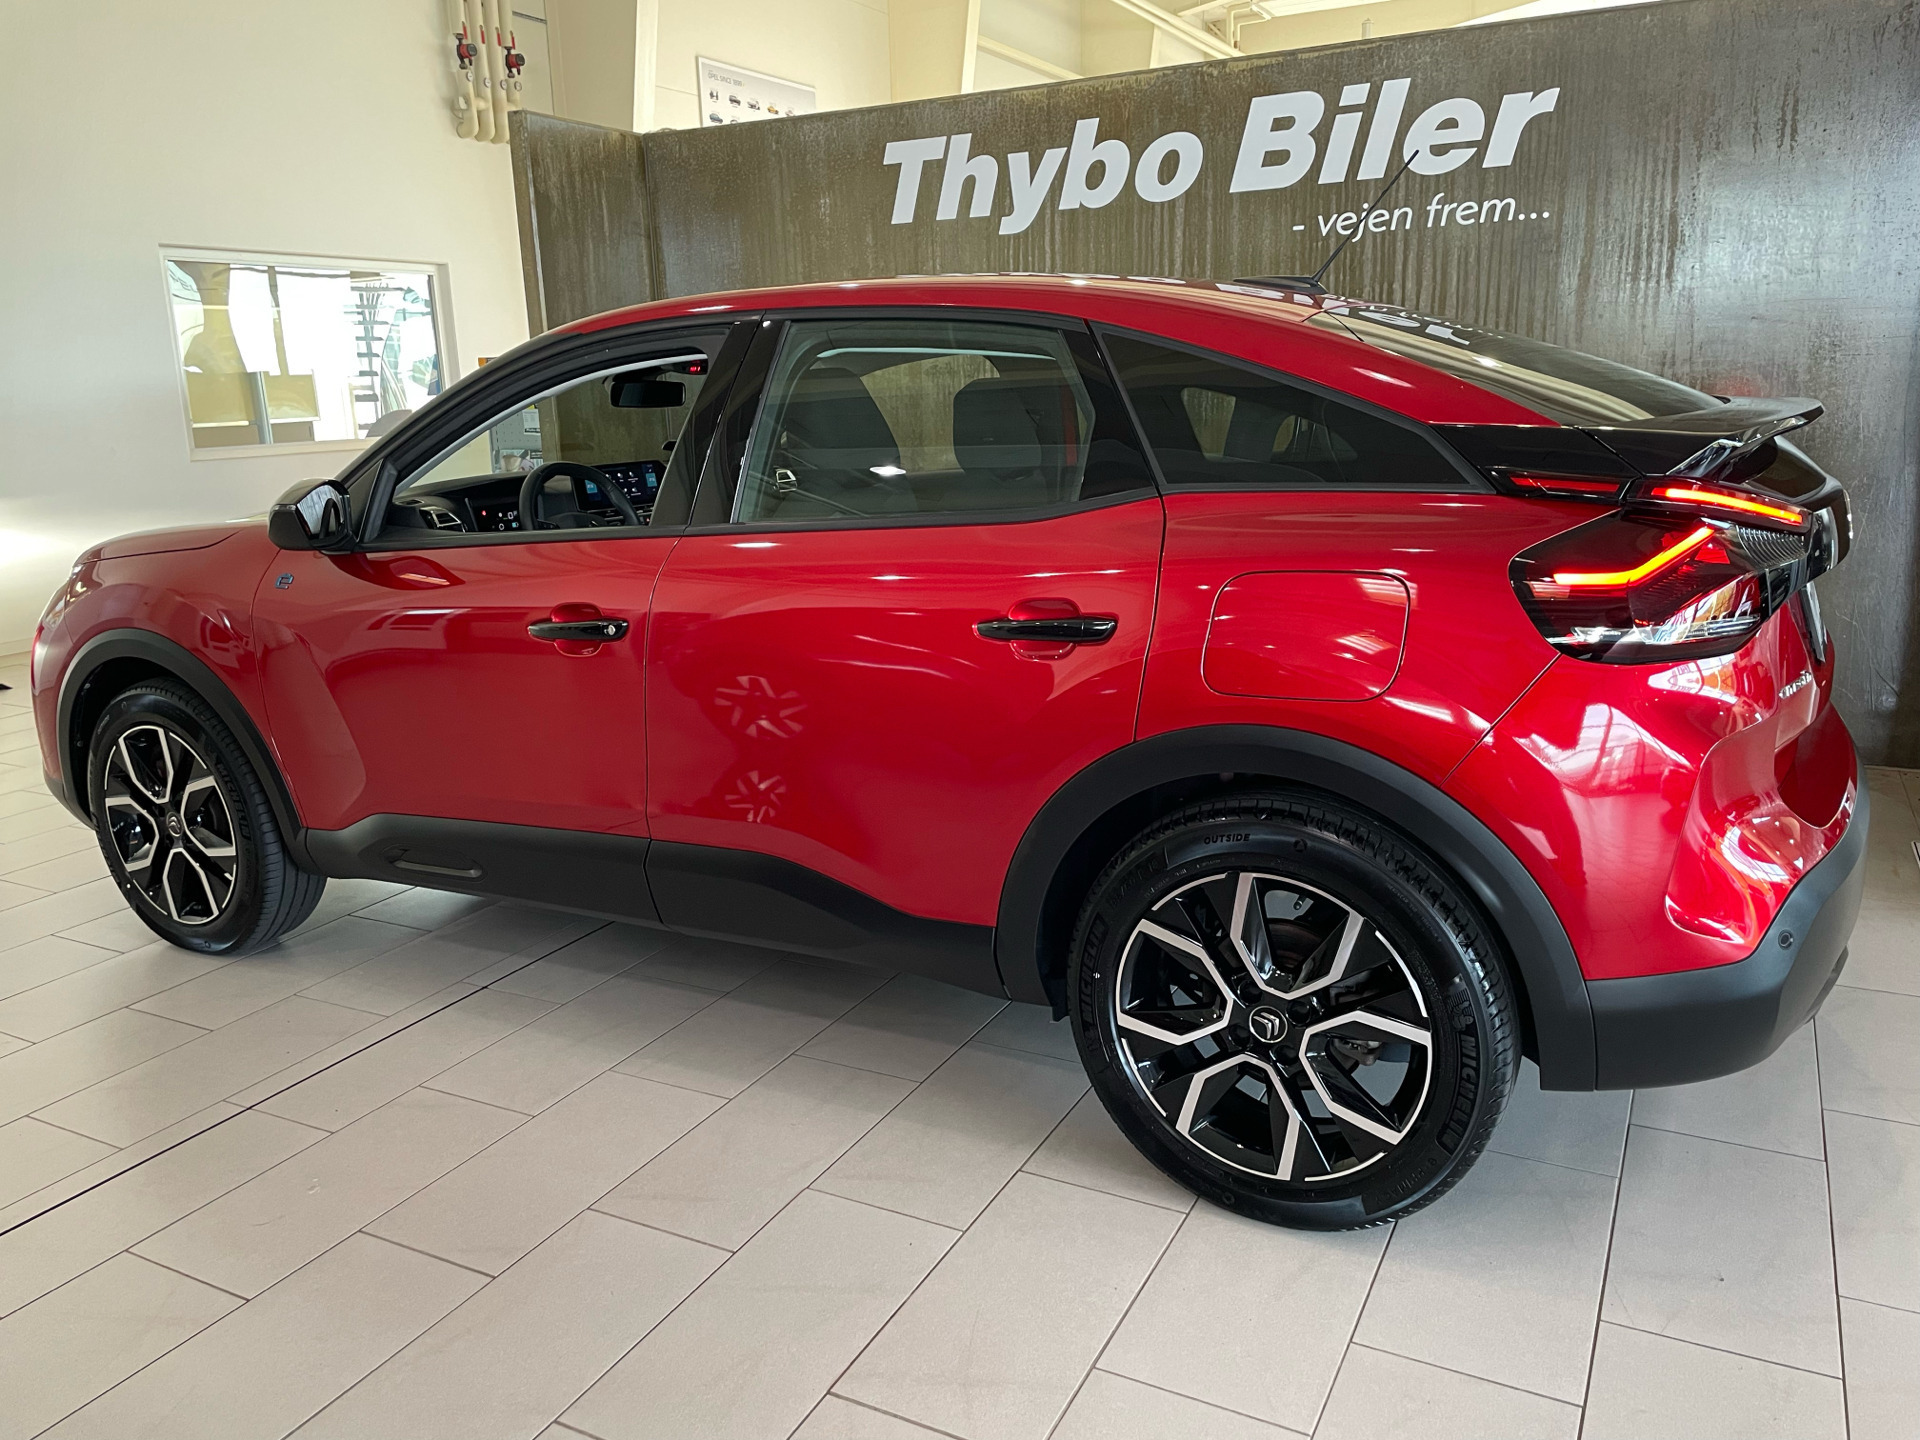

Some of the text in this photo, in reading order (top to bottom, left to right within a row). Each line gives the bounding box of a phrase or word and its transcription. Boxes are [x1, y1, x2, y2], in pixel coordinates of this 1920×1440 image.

[882, 77, 1561, 235] Thybo Biler
[1317, 202, 1413, 243] vejen
[1426, 192, 1550, 228] frem...
[1203, 832, 1251, 844] OUTSIDE
[1080, 914, 1109, 1025] MICHELIN
[1442, 1033, 1477, 1150] MICHELIN
